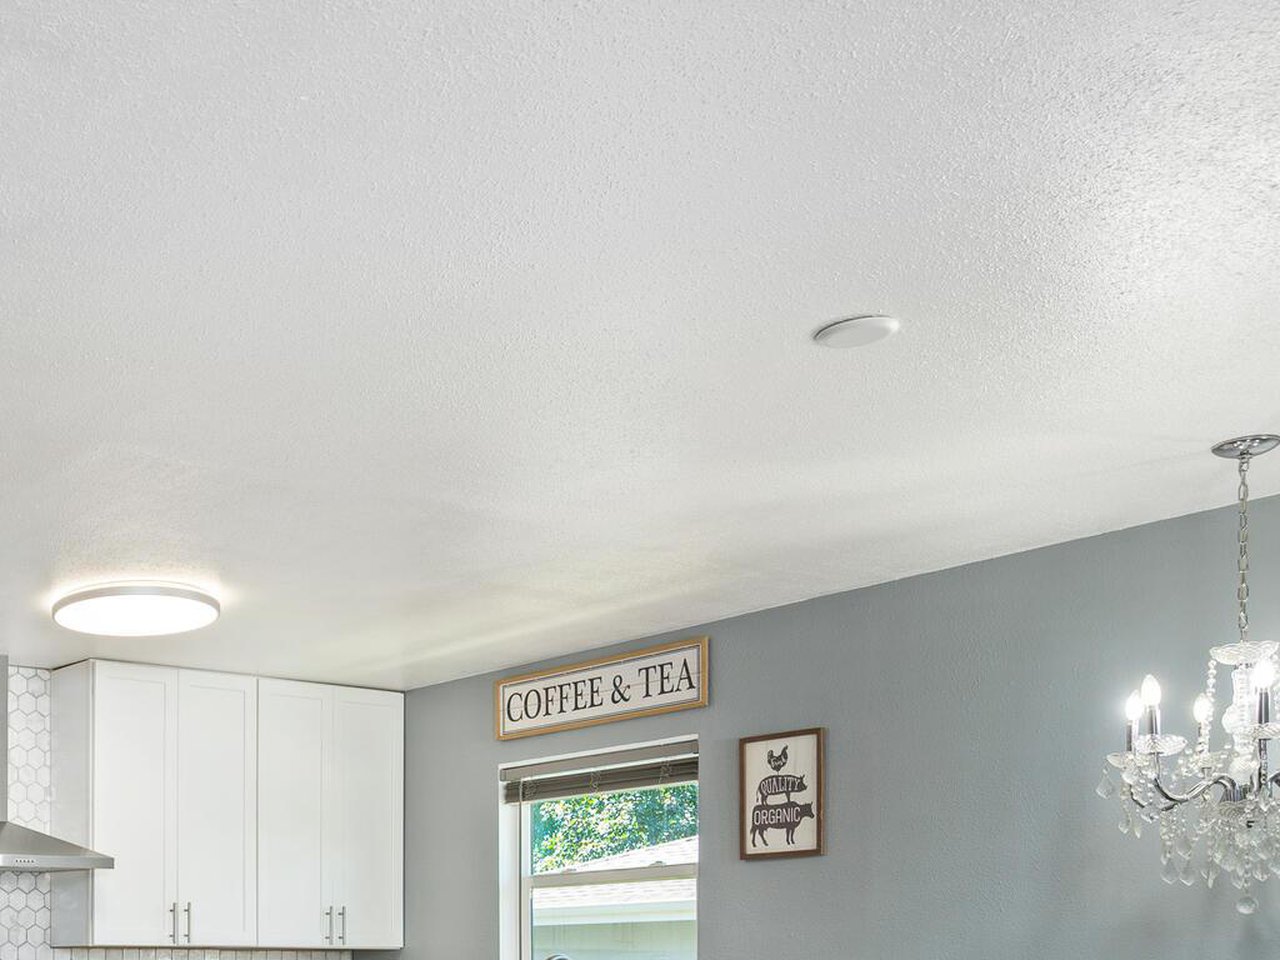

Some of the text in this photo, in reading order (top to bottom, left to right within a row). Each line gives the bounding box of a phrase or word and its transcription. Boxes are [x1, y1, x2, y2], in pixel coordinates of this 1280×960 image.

[506, 658, 697, 722] COFFEE & TEA
[761, 777, 800, 796] QUALITY
[753, 806, 801, 826] ORGANIC
